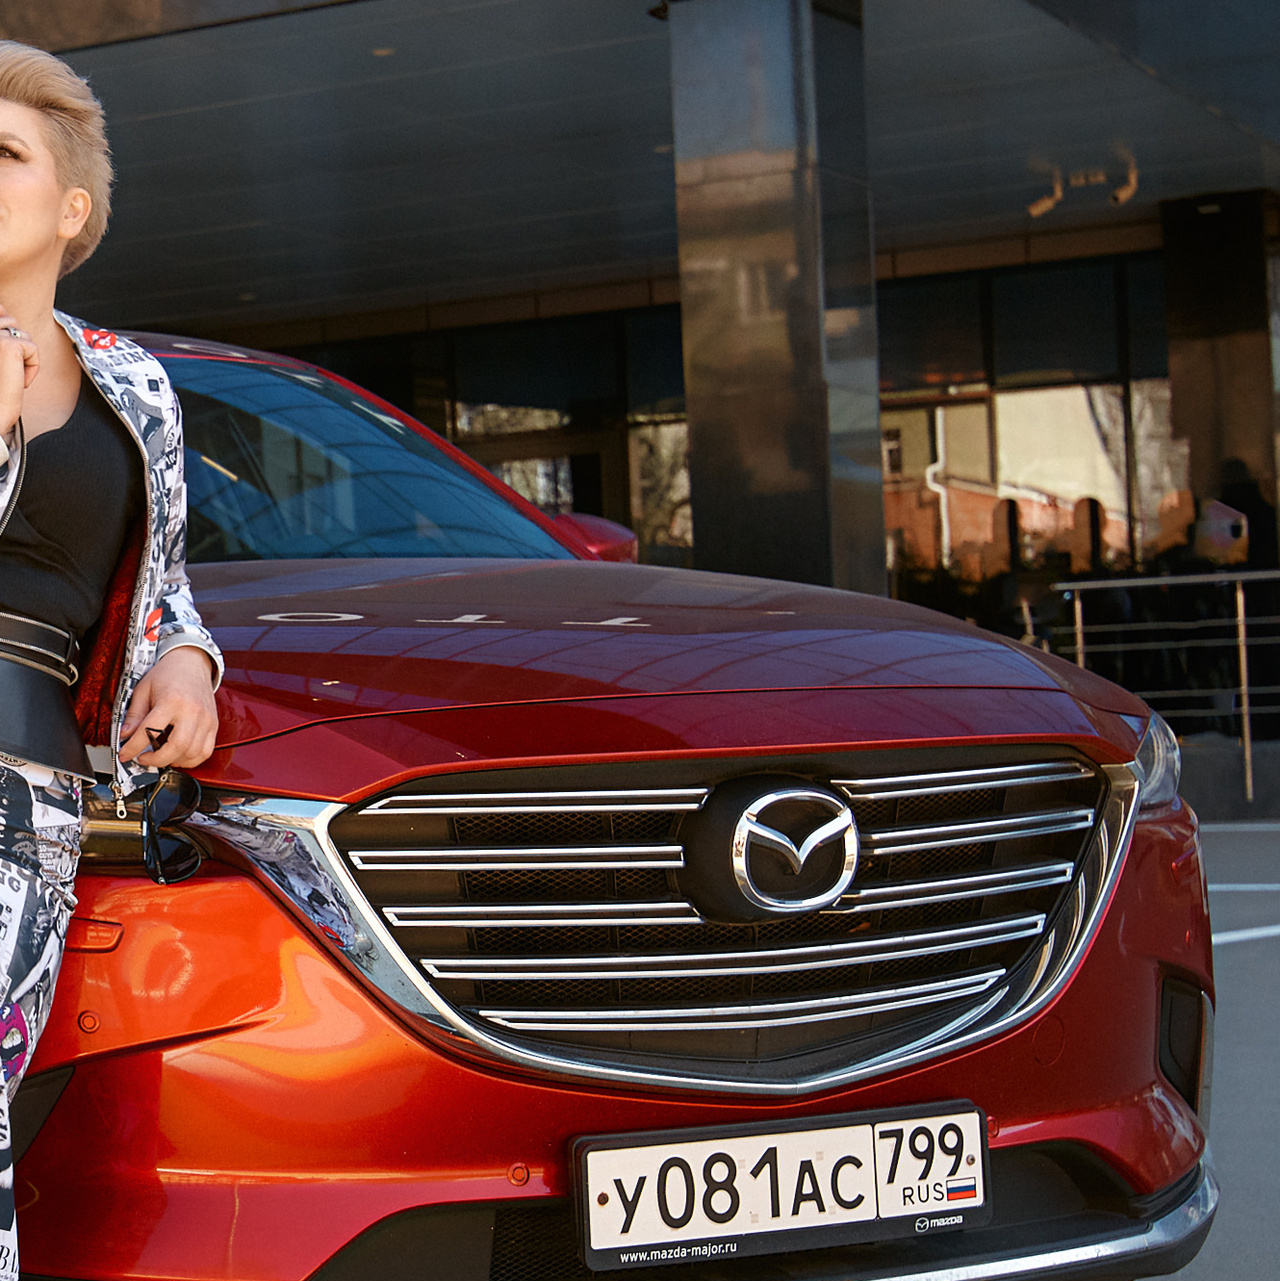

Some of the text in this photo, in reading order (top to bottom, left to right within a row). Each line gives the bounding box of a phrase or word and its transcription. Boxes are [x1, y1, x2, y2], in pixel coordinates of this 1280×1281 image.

[877, 1122, 965, 1185] 799
[901, 1181, 946, 1207] RUS
[619, 1240, 738, 1264] www.mazda-major.ru
